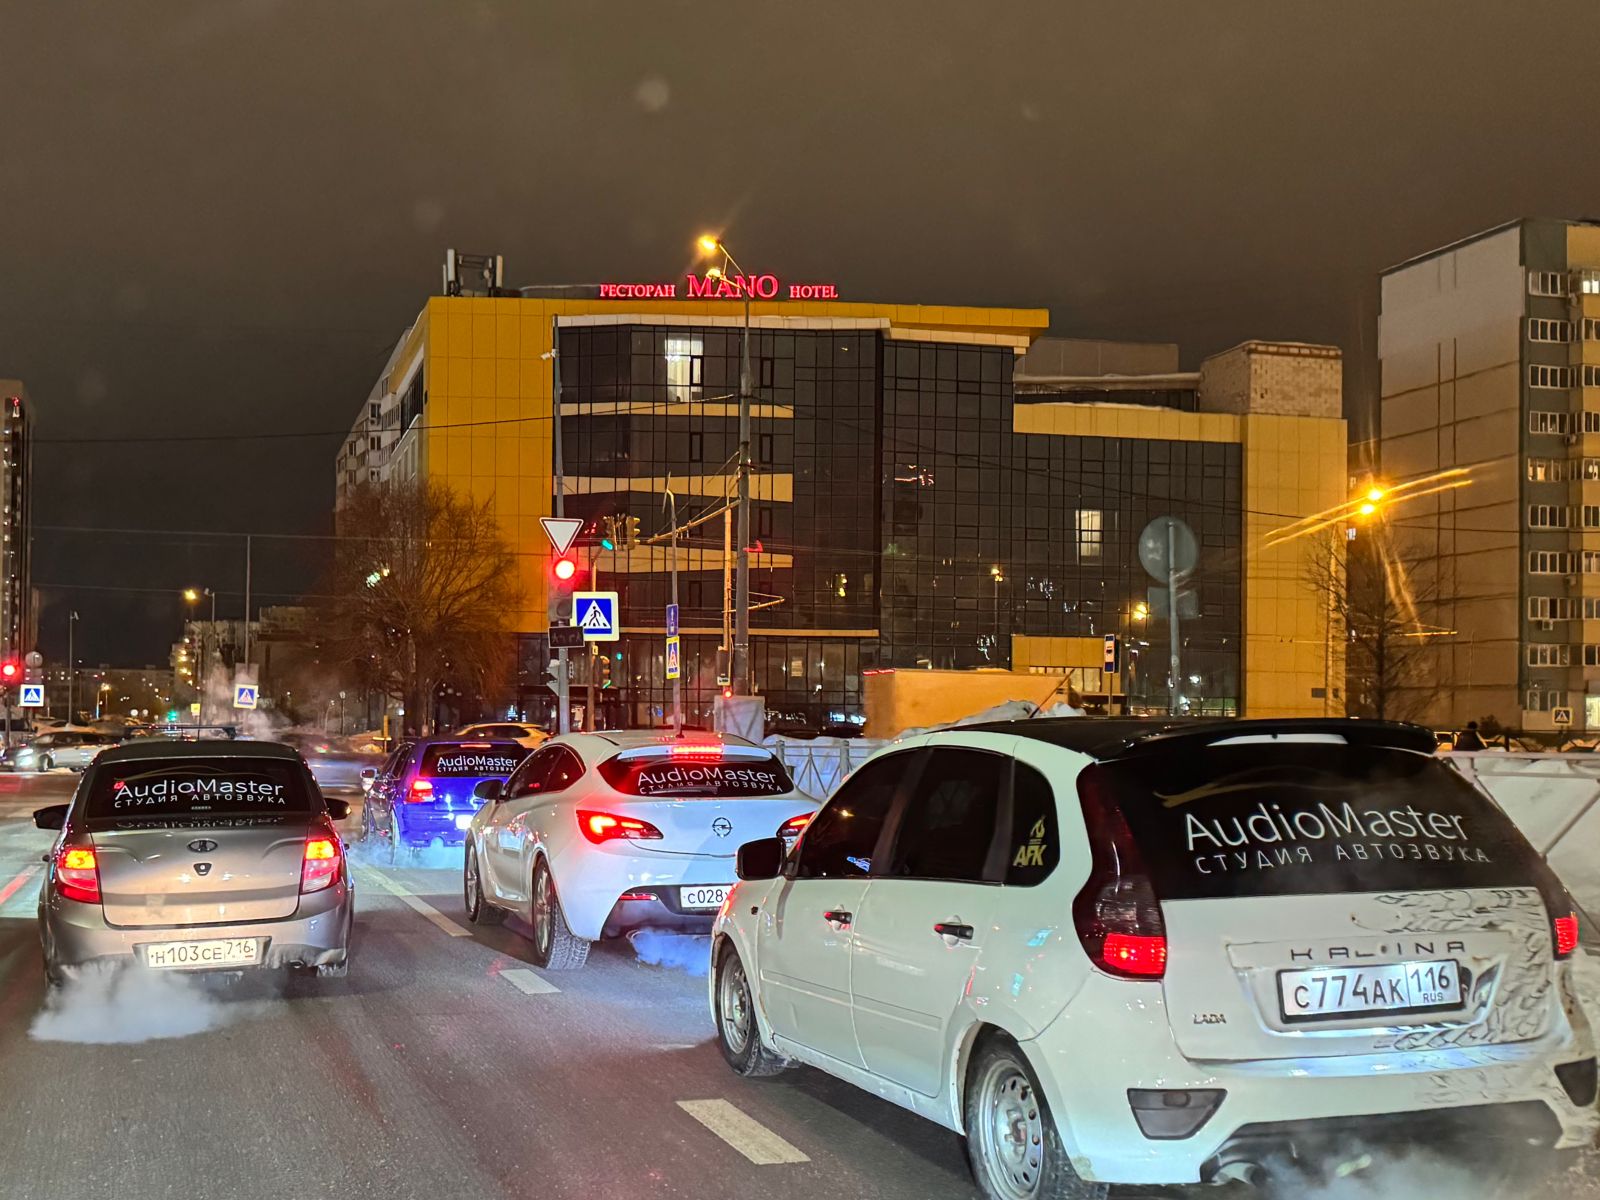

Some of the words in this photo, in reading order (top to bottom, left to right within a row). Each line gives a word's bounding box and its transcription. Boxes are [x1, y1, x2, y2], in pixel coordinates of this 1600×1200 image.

[600, 284, 676, 298] РЕСТОРАН
[686, 274, 779, 299] MANO
[789, 285, 838, 299] HOTEL
[437, 755, 518, 767] AudioMaster
[637, 766, 777, 786] AudioMaster
[114, 778, 283, 800] AudioMaster
[114, 794, 178, 809] СТУДИЯ
[191, 793, 286, 805] АВТОЗВУКА
[1185, 801, 1469, 851] AudioMaster
[1195, 846, 1314, 875] СТУДИЯ
[1335, 843, 1492, 864] АВТОЗВУКА
[1290, 940, 1466, 961] KALINA
[1422, 992, 1444, 1004] RUS
[1192, 1013, 1227, 1025] LADA
